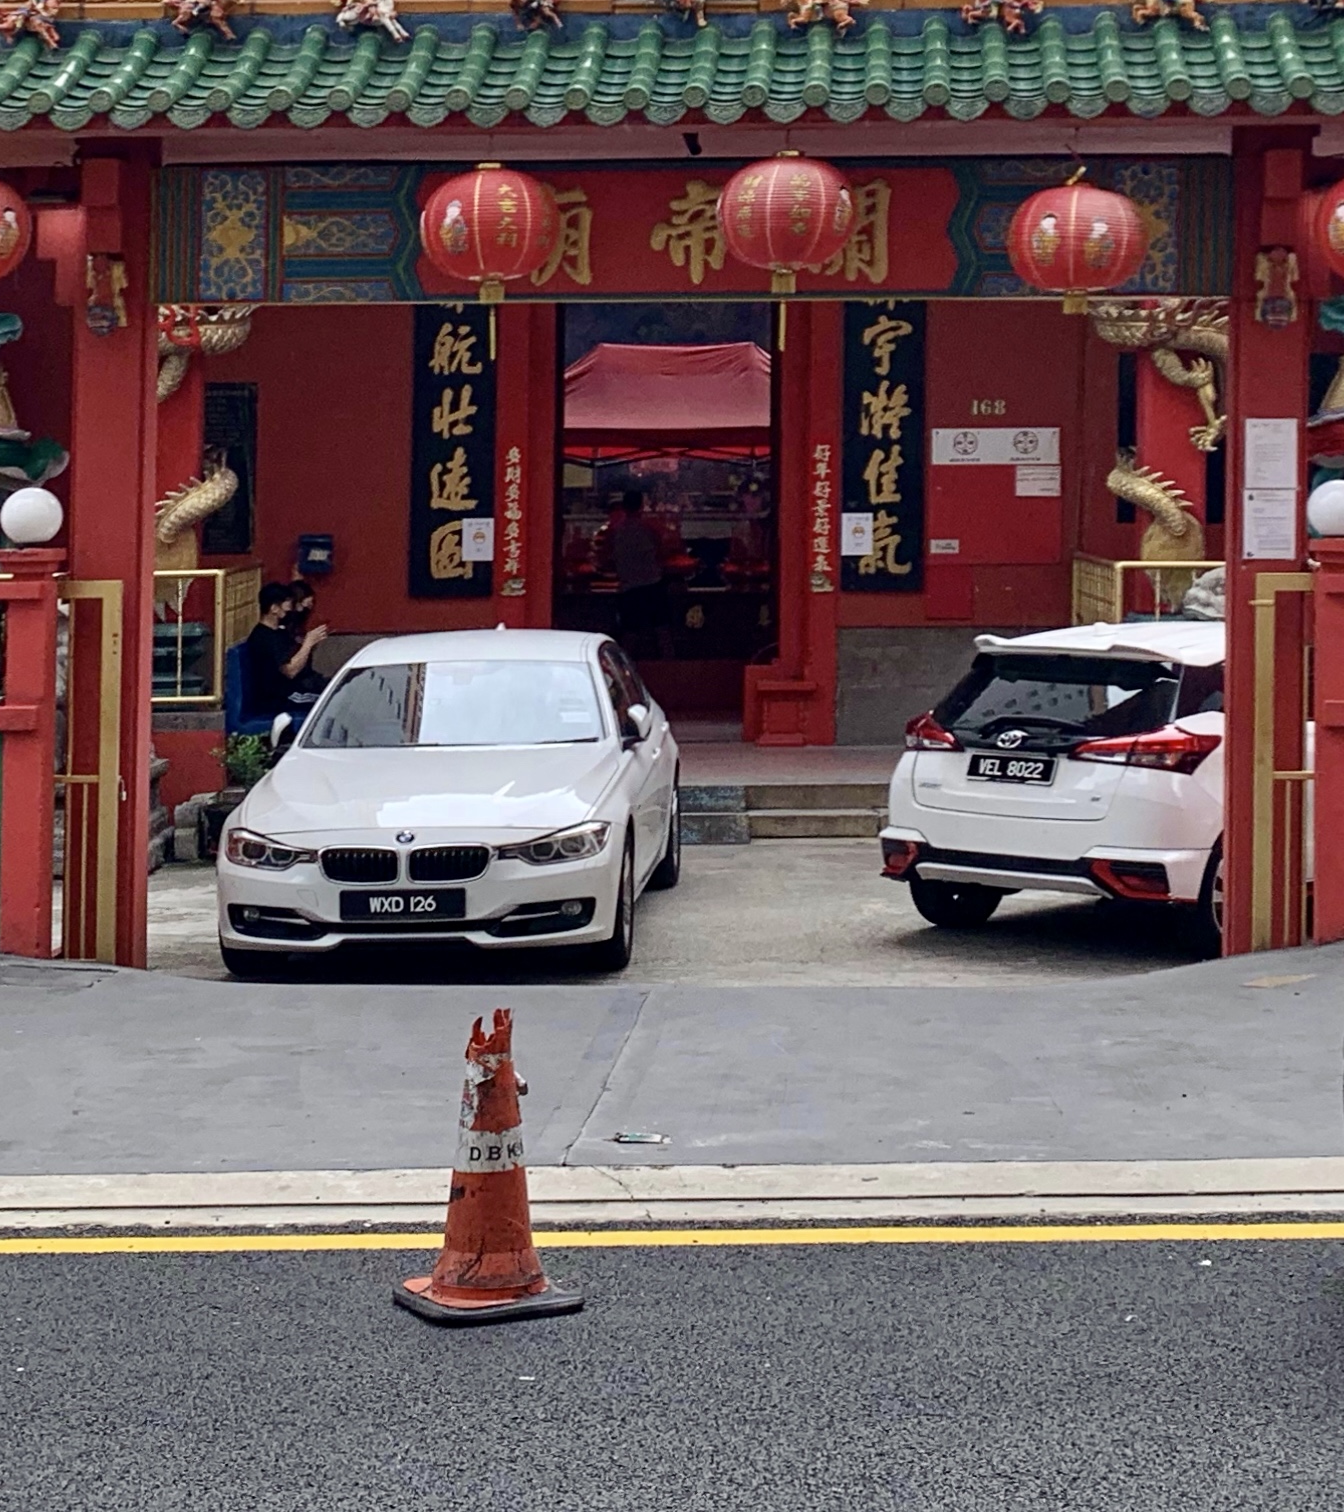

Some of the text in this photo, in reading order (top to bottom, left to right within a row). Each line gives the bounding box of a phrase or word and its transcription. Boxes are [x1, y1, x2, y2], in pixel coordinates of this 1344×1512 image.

[497, 184, 518, 248] 大吉大利
[971, 399, 1006, 415] 168
[979, 758, 1044, 778] VEL 8022
[369, 895, 436, 913] WXD 126
